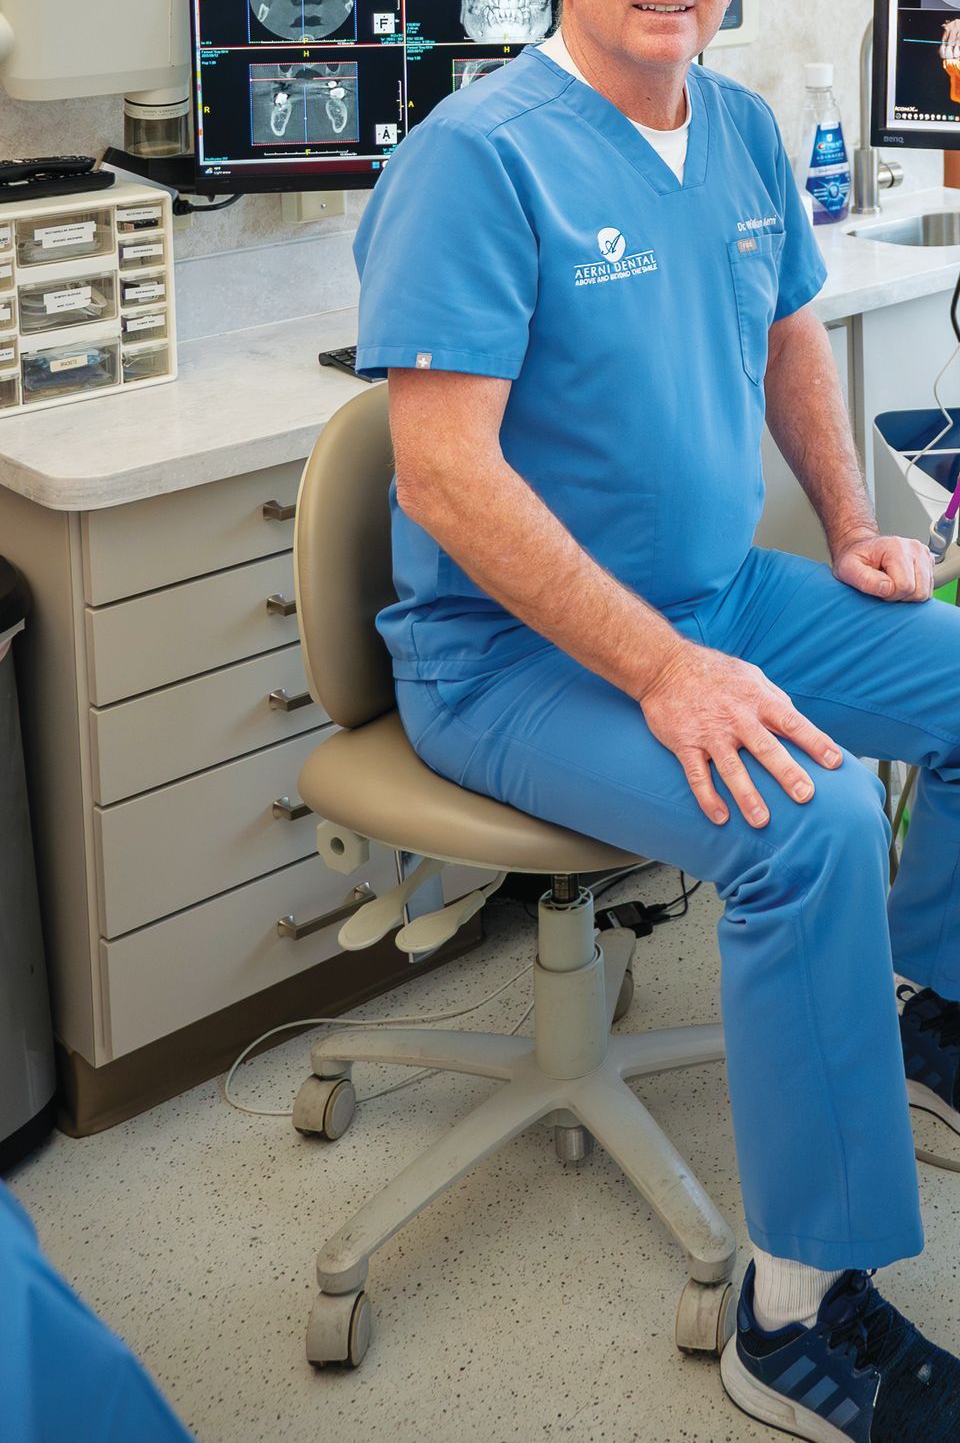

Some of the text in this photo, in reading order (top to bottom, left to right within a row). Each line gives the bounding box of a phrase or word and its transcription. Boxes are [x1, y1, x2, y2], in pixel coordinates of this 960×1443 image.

[379, 18, 389, 29] F
[303, 49, 310, 58] H
[504, 45, 511, 53] H
[408, 100, 415, 108] A
[203, 106, 211, 114] R
[382, 128, 391, 140] A
[575, 254, 657, 280] AERNI DENTAL
[575, 262, 658, 287] ABOVE AND BEYOND THE SMILE
